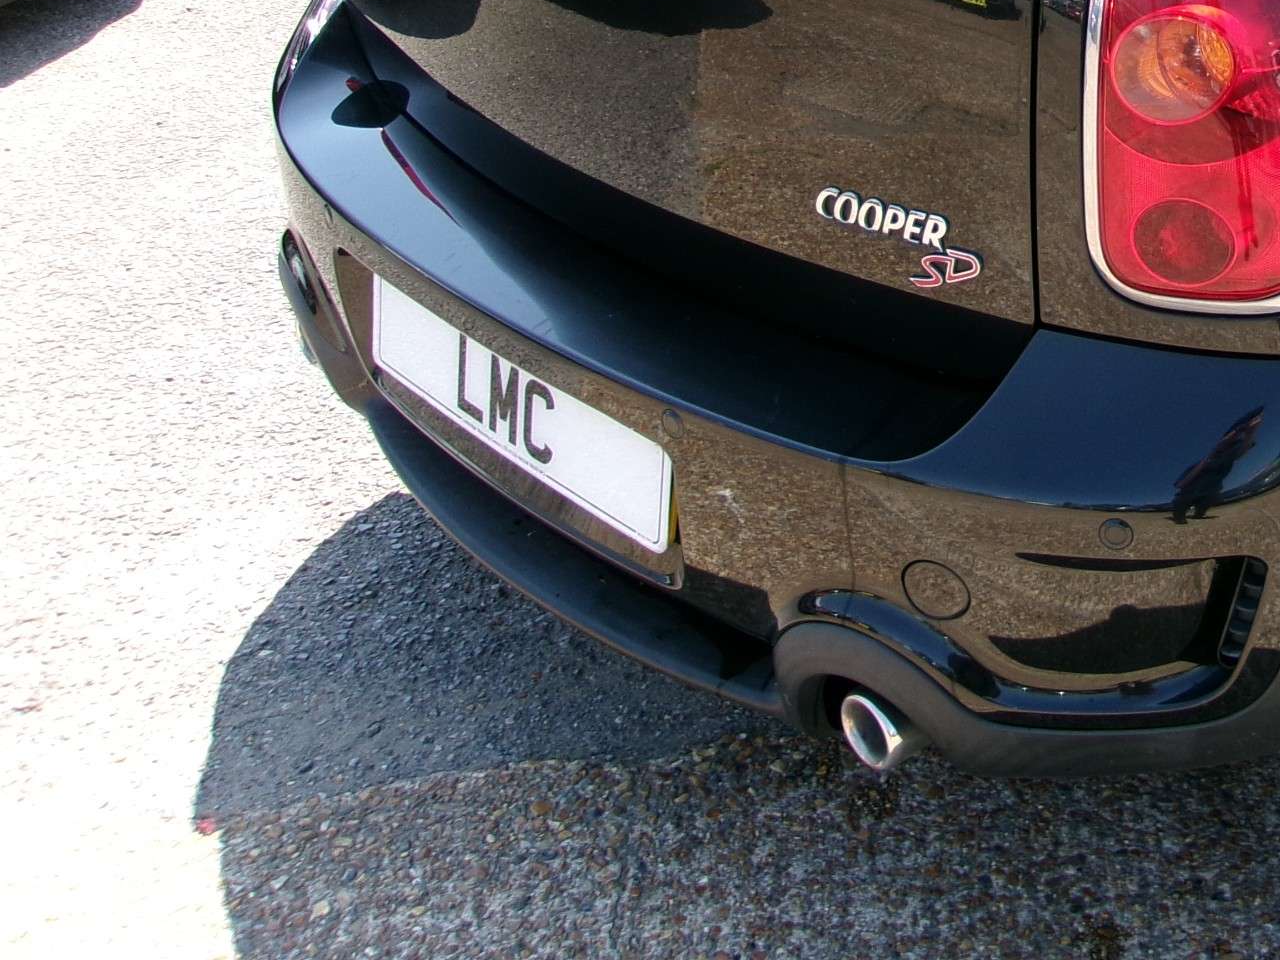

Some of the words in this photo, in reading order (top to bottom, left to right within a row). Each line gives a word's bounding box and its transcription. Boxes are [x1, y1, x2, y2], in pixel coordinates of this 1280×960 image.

[815, 186, 949, 253] COOPER
[908, 247, 982, 288] SD
[457, 331, 555, 465] LMC
